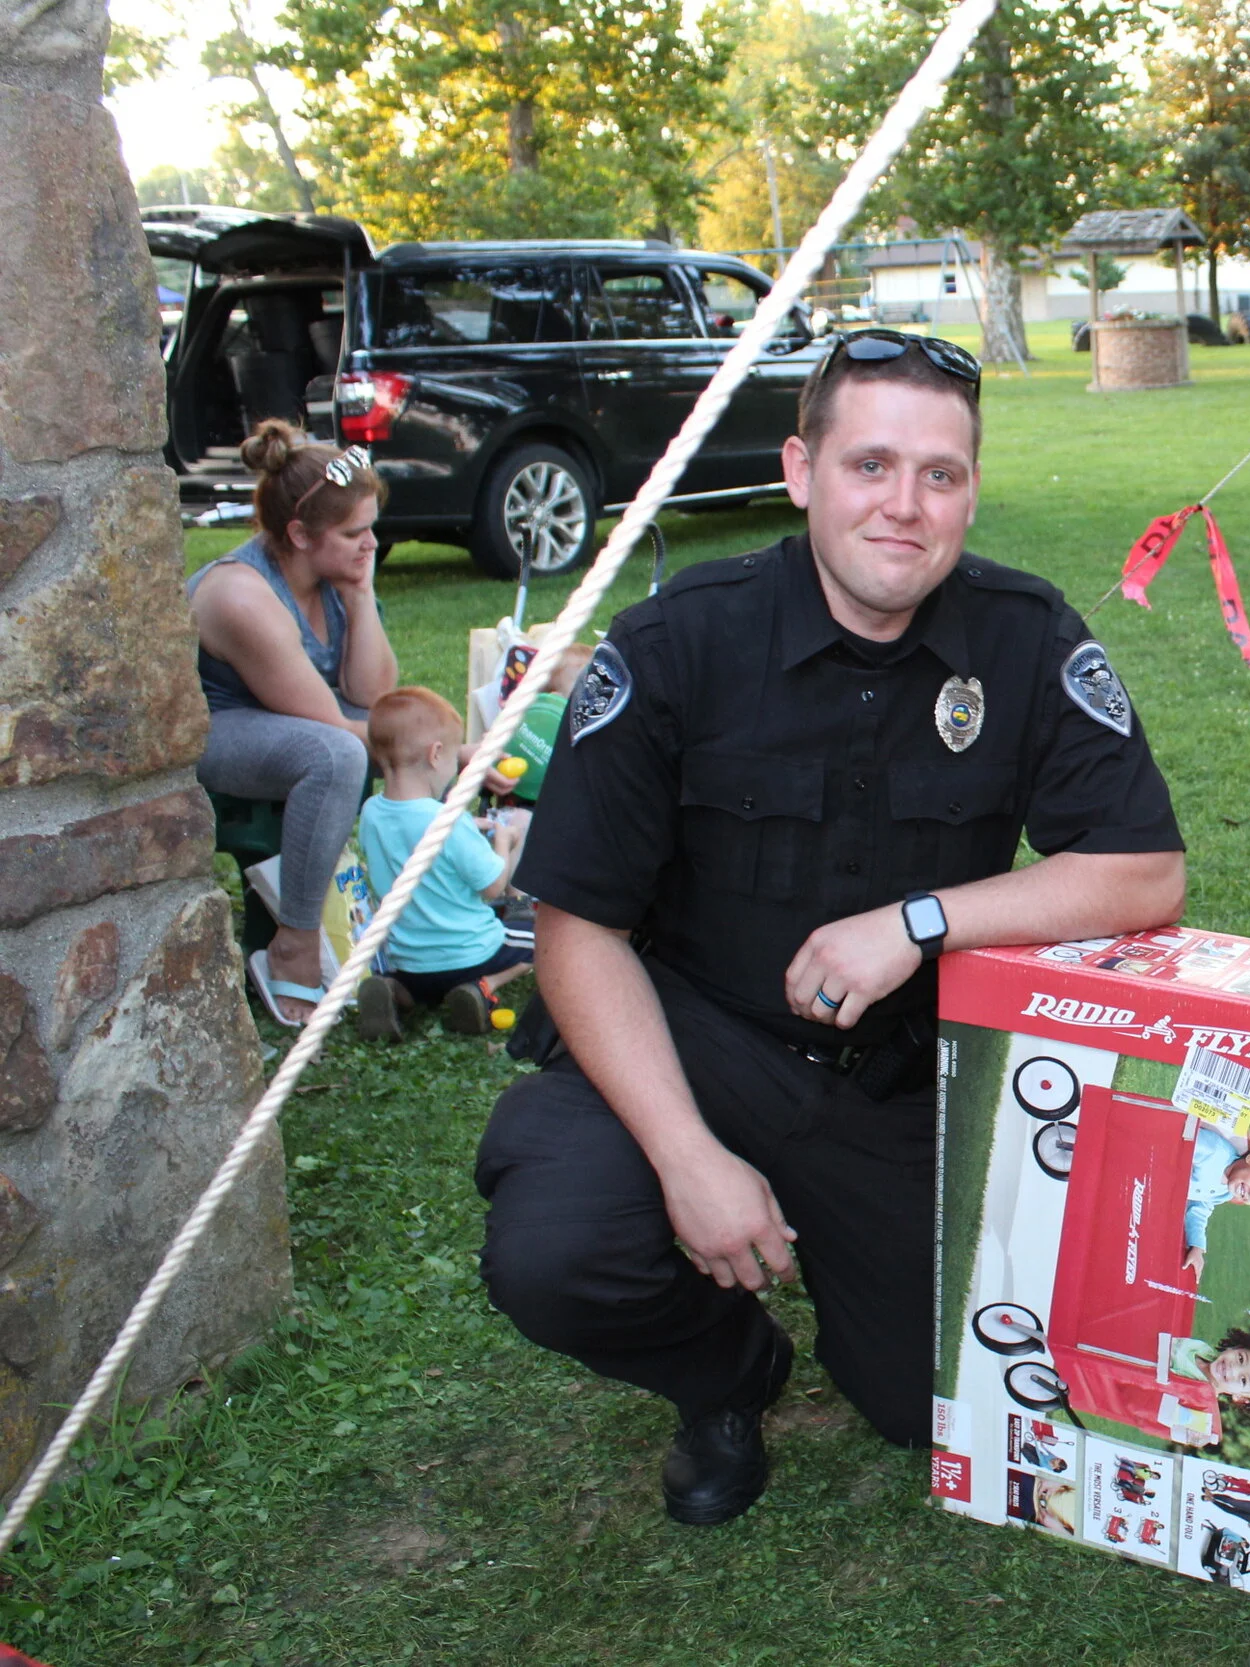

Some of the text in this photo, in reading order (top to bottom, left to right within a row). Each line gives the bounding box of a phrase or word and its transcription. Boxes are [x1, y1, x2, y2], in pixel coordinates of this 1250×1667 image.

[1020, 992, 1136, 1026] RADIO
[937, 1403, 946, 1420] 150
[931, 1456, 940, 1488] YEARS
[1092, 1492, 1102, 1520] VERSATILE
[1185, 1506, 1195, 1523] HAND
[1184, 1525, 1193, 1540] FOLD
